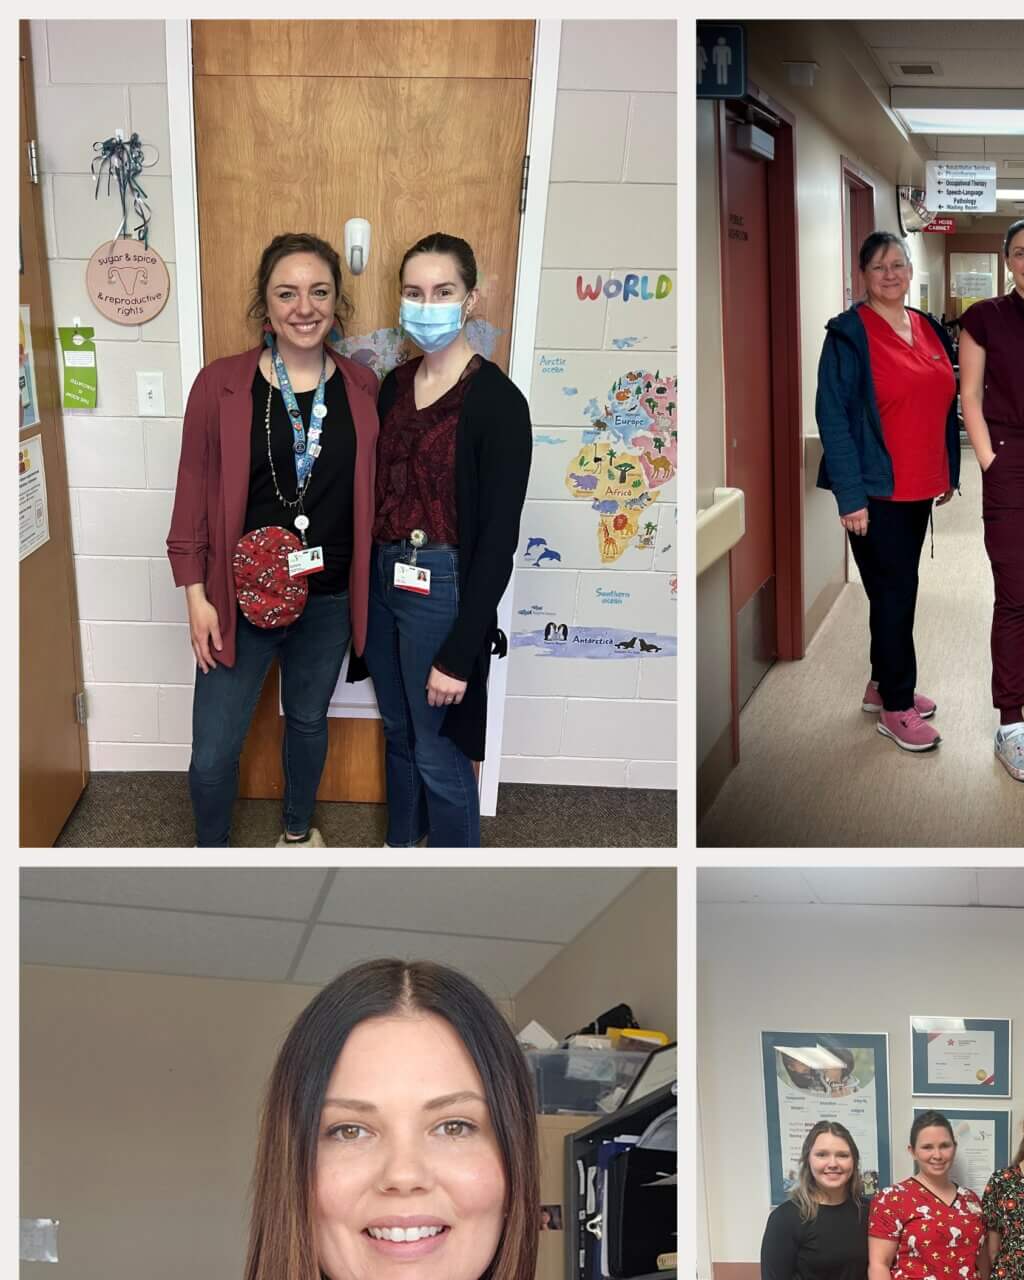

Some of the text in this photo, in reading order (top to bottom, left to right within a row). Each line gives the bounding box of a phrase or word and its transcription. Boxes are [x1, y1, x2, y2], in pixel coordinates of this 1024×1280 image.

[98, 252, 157, 265] sugar & spice
[576, 273, 673, 302] WORLD
[97, 291, 162, 306] & reproductive
[117, 306, 144, 317] rights
[539, 355, 567, 366] Arctic
[541, 365, 564, 374] ocean
[614, 414, 645, 427] Europe
[604, 486, 632, 497] Africa
[572, 635, 614, 646] Antarctica
